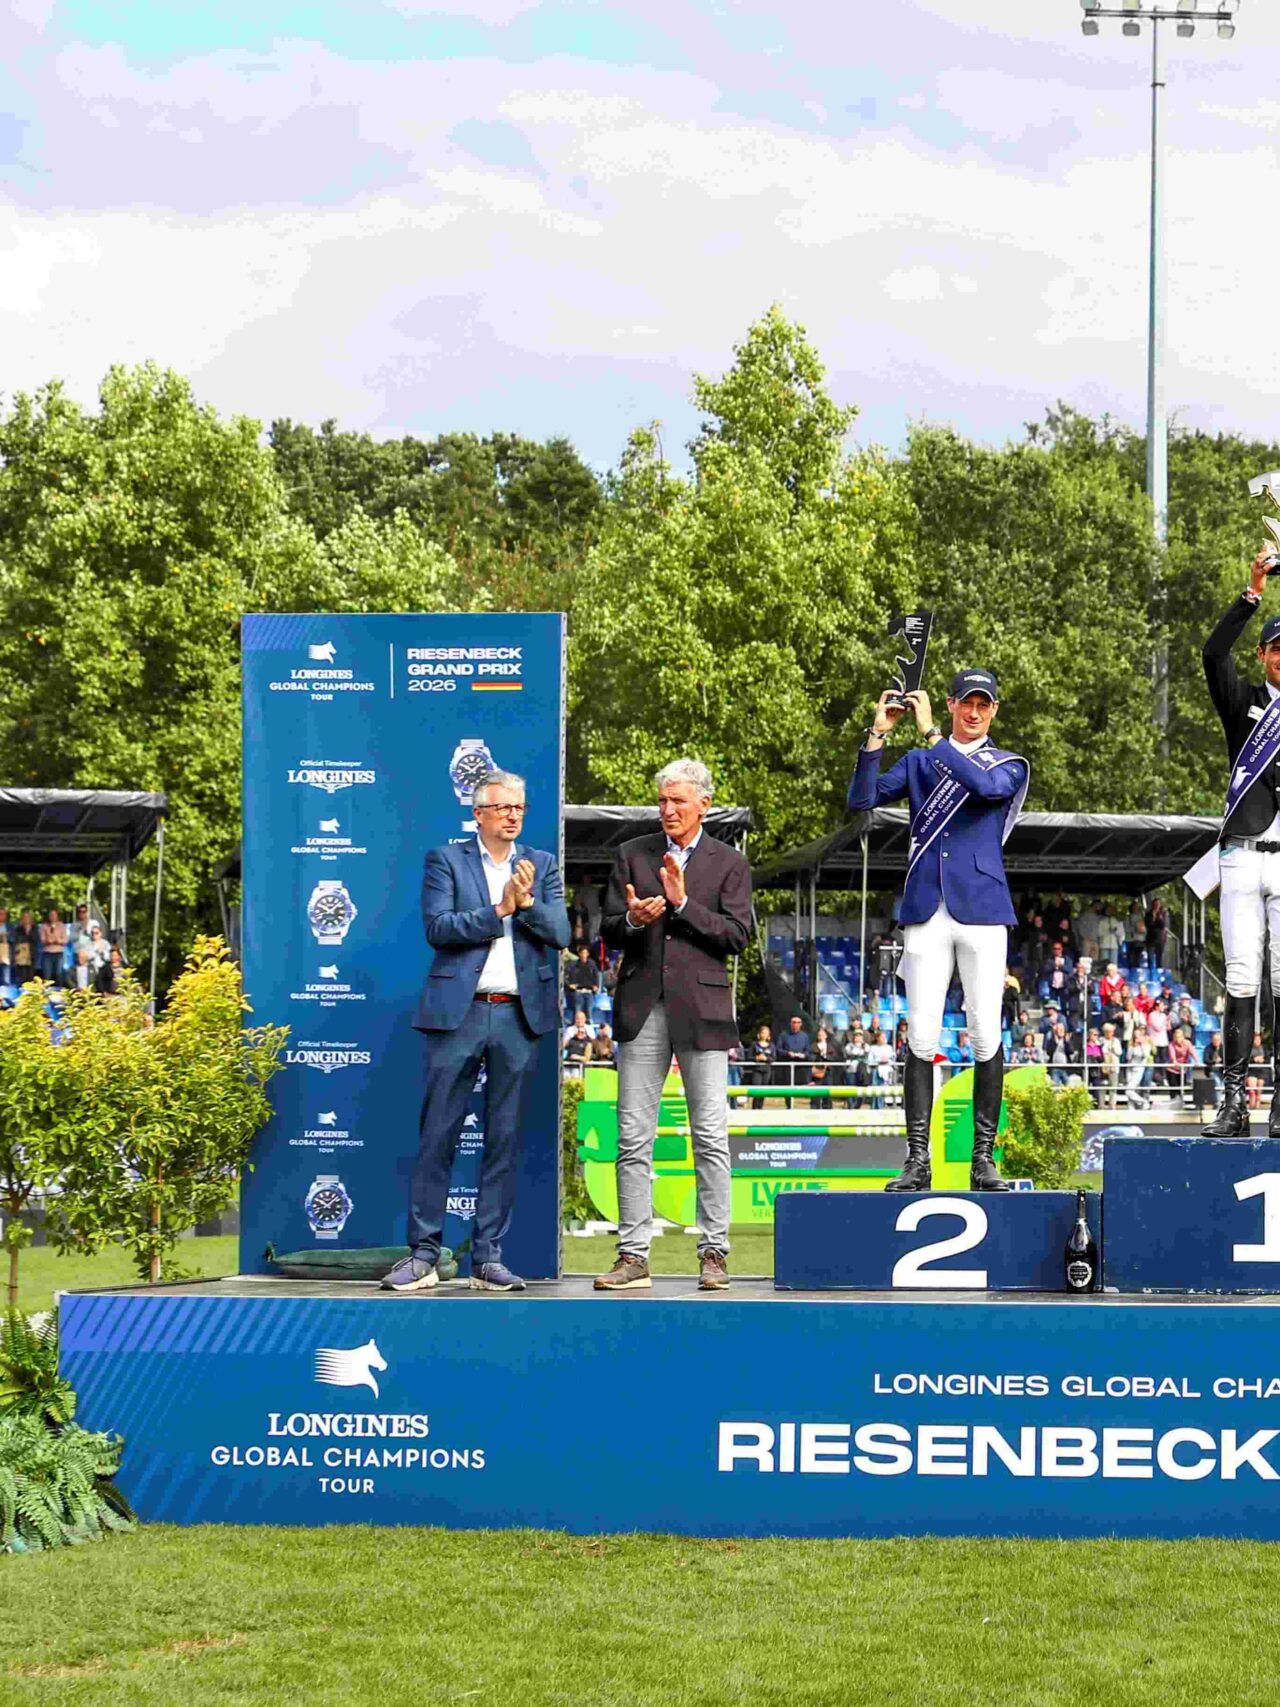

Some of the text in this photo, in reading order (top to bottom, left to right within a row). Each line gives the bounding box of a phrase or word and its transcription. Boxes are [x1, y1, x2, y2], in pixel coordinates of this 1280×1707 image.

[408, 648, 521, 659] RIESENBECK
[291, 669, 353, 679] LONGINES
[408, 663, 521, 675] GRAND PRIX
[270, 682, 374, 690] GLOBAL CHAMPIONS
[408, 680, 456, 691] 2026
[288, 770, 375, 783] LONGINES
[322, 1041, 358, 1049] Timekeeper
[286, 1051, 371, 1064] LONGINES
[892, 1197, 988, 1288] 2
[875, 1374, 1049, 1396] LONGINES
[1064, 1376, 1201, 1397] GLOBAL
[268, 1413, 428, 1437] LONGINES
[211, 1446, 485, 1468] GLOBAL CHAMPIONS
[719, 1422, 1280, 1480] RIESENBECK
[319, 1478, 374, 1493] TOUR
